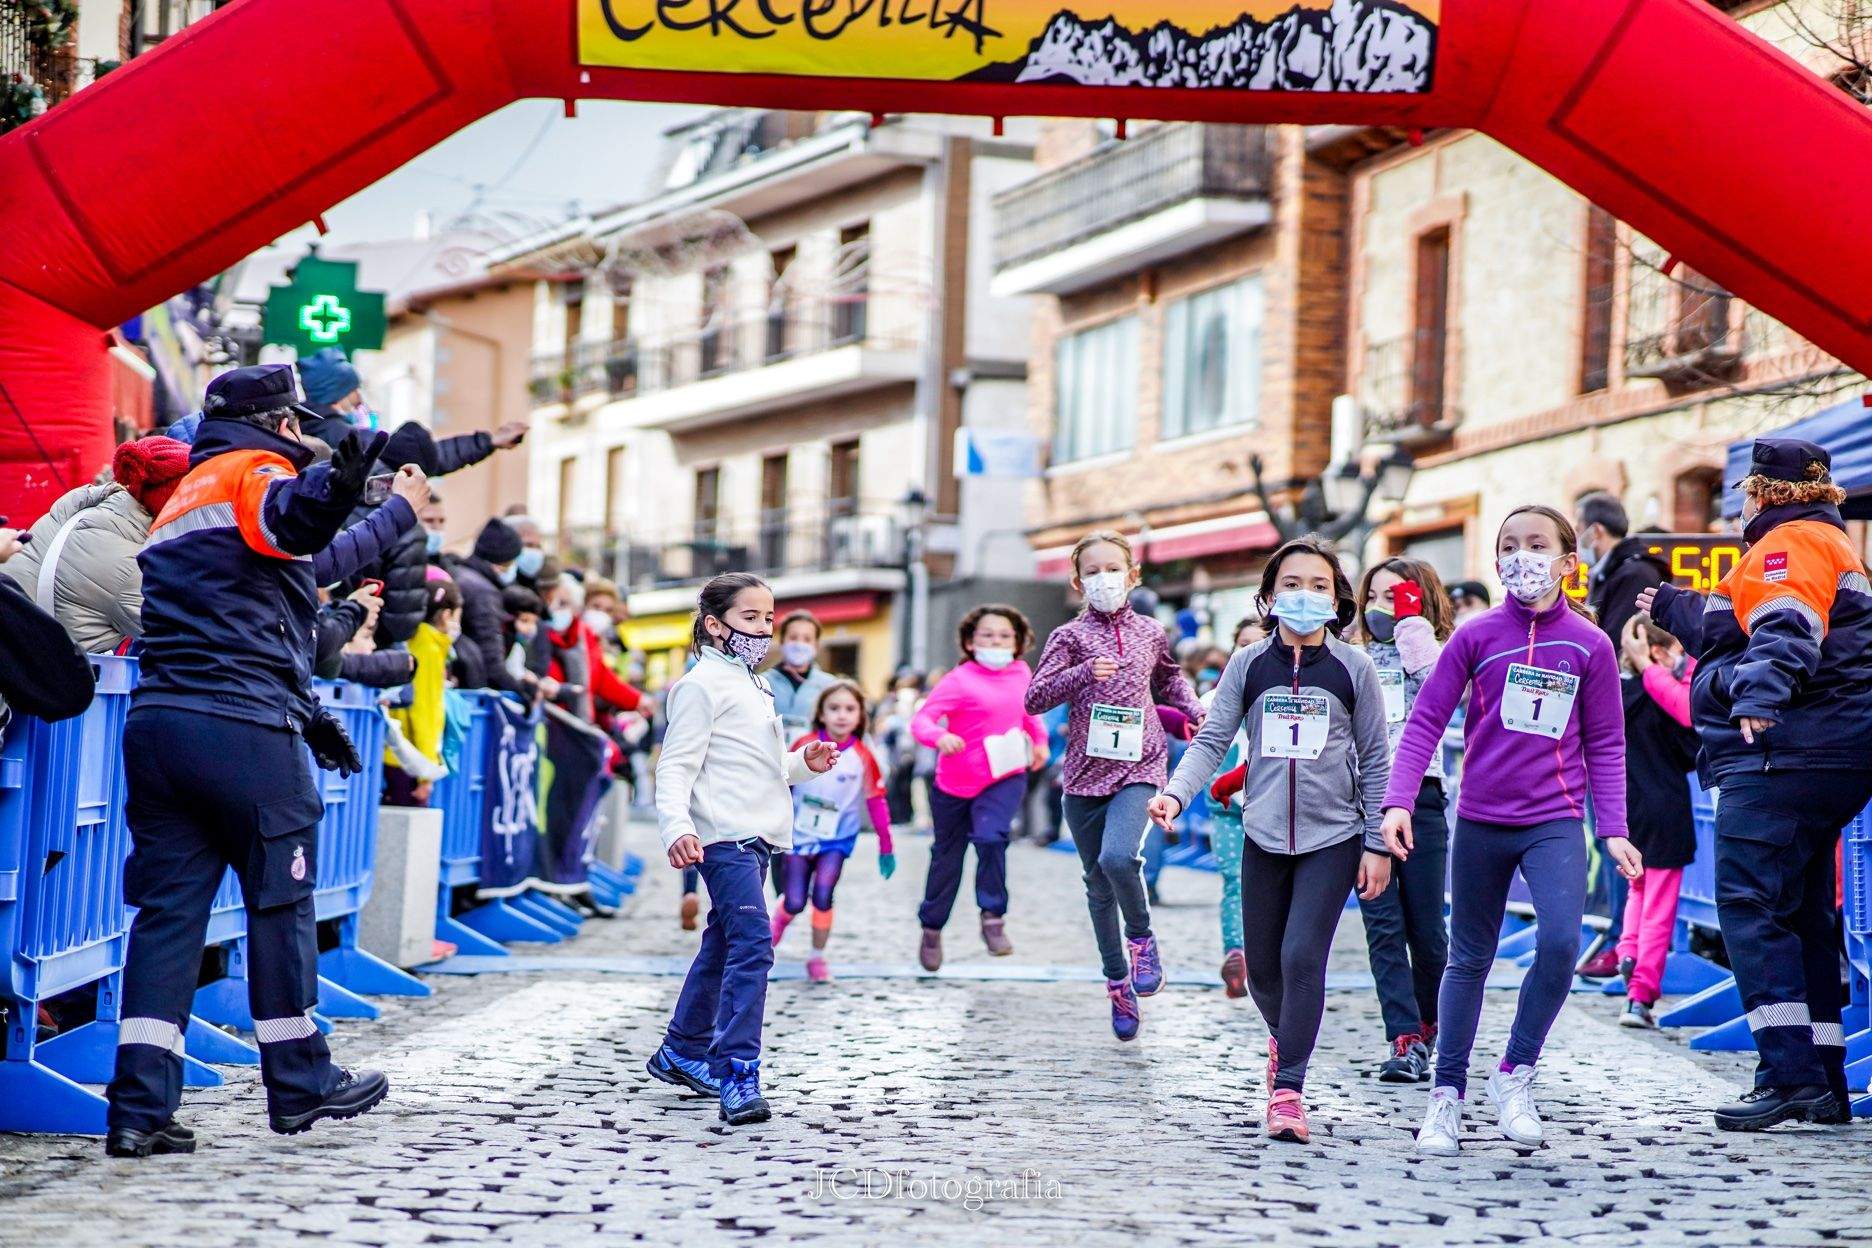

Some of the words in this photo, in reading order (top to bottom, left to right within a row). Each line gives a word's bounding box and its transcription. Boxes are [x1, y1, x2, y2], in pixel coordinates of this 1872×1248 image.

[1532, 697, 1543, 721] 1
[1111, 730, 1120, 748] 1
[1288, 722, 1299, 746] 1
